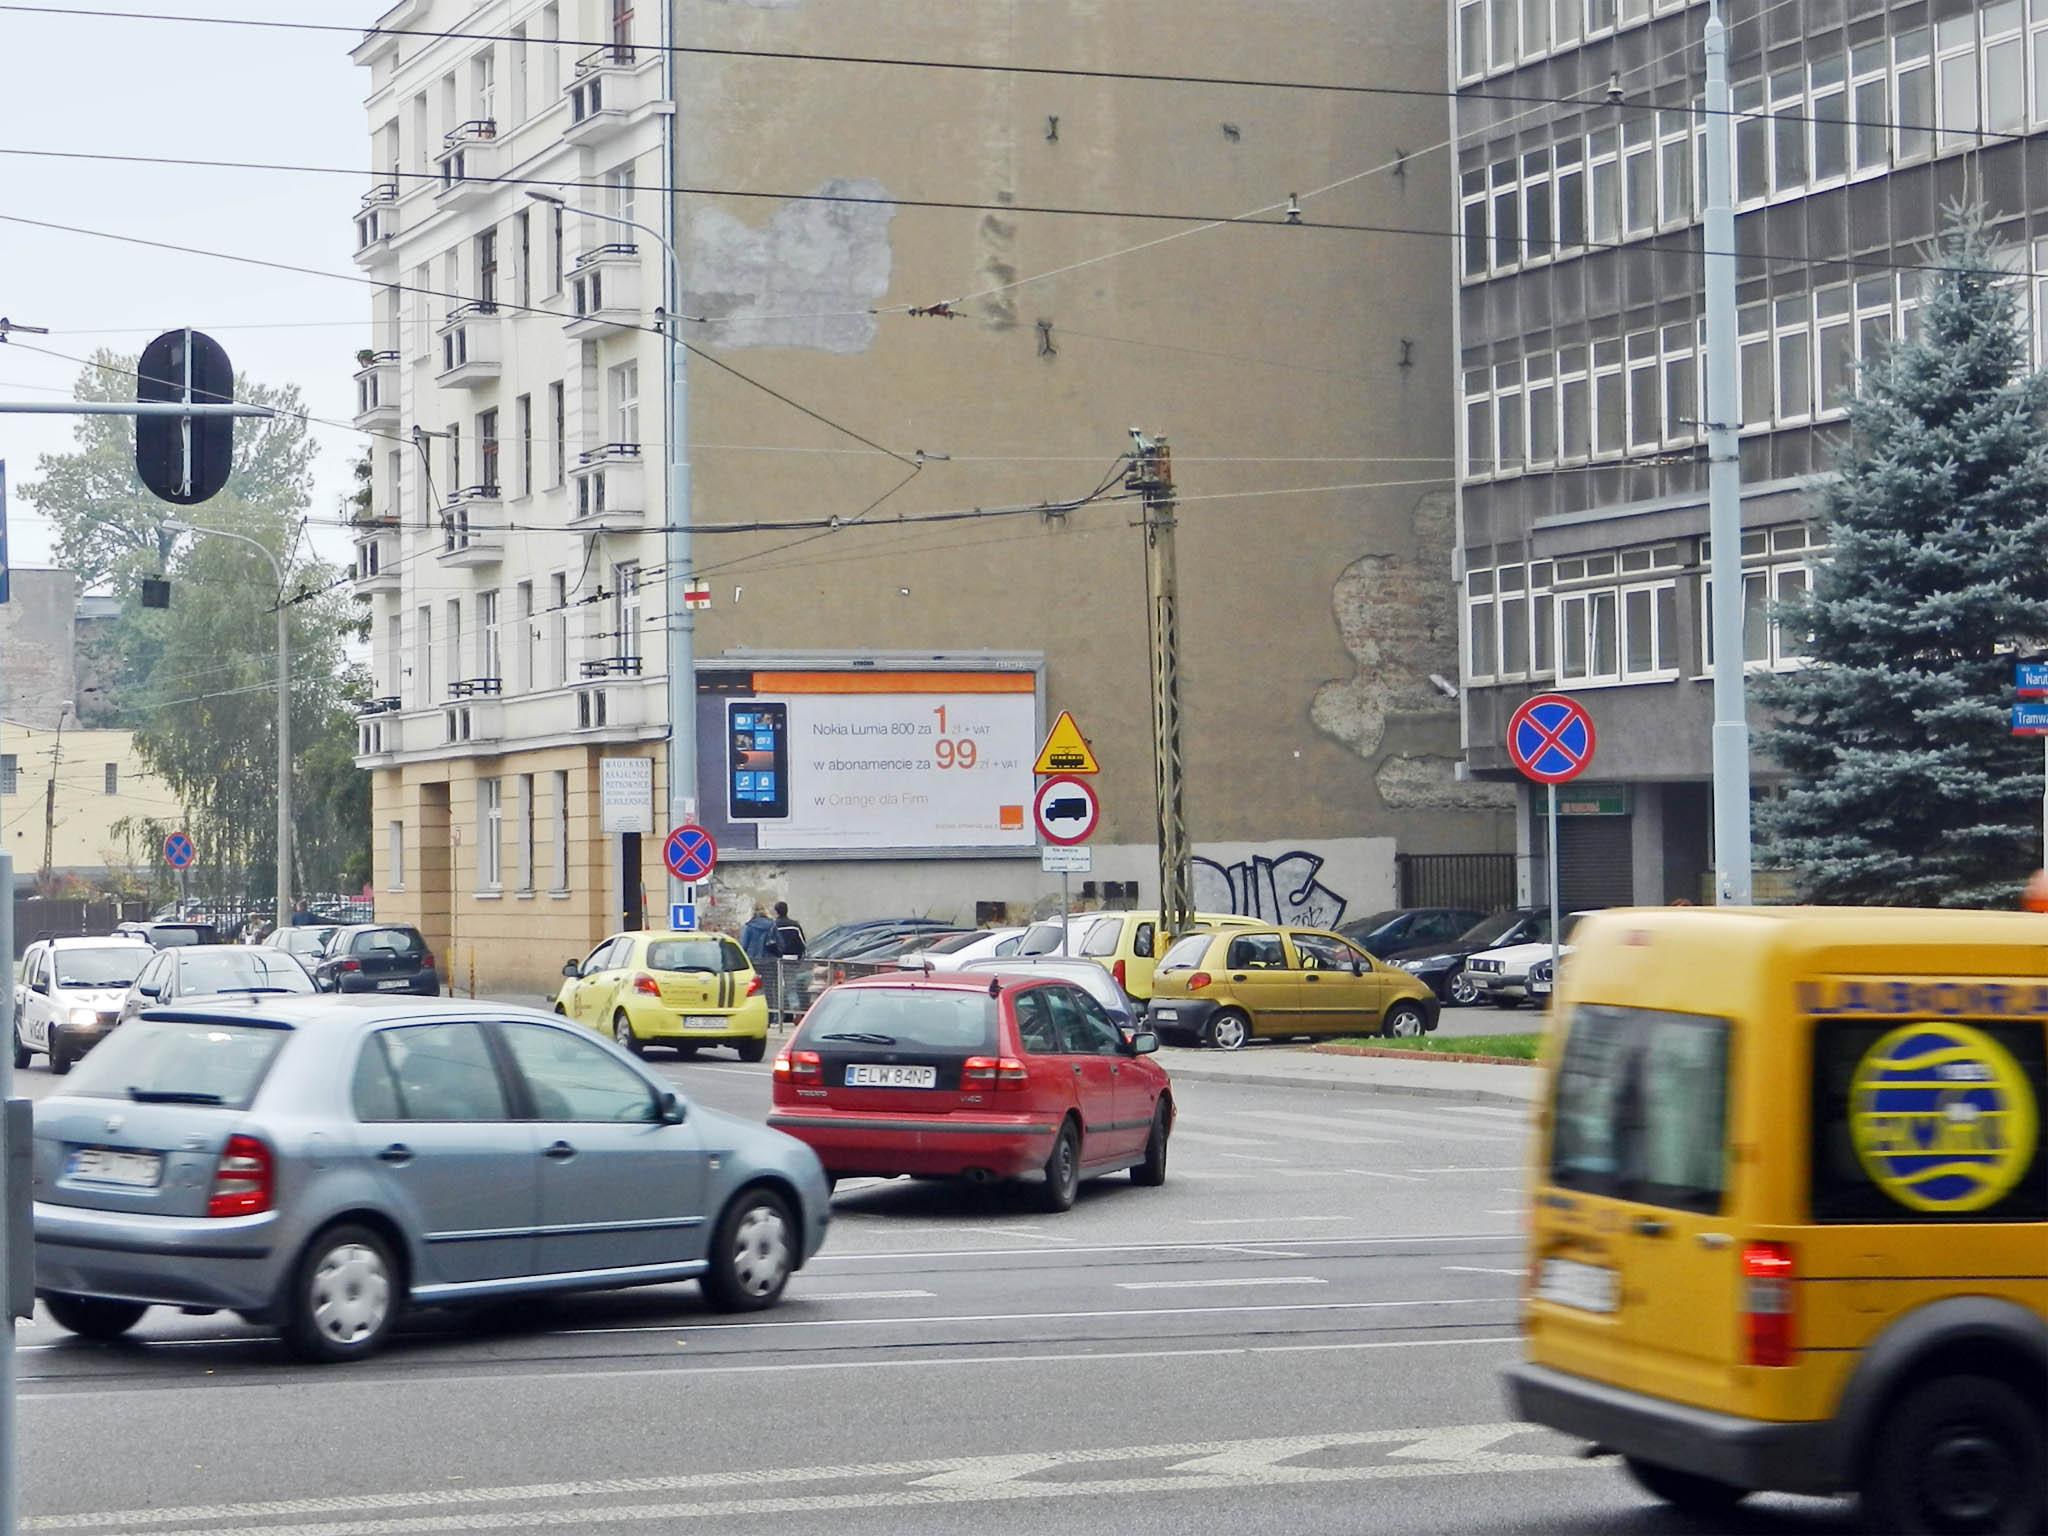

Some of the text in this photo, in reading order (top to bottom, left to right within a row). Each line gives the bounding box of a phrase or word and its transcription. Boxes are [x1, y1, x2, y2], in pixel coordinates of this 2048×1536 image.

[813, 723, 848, 735] Nokia
[852, 723, 887, 735] Lumia
[891, 722, 915, 735] 800
[918, 724, 932, 735] za
[933, 704, 946, 734] 1
[972, 725, 991, 735] VAT
[813, 761, 825, 770] w
[828, 758, 913, 770] abonamencie
[916, 760, 931, 770] za
[935, 739, 977, 769] 99
[1001, 760, 1018, 769] VAT
[814, 792, 929, 808] w Orange dla Firm
[679, 909, 690, 926] L
[856, 1067, 932, 1085] ELW 84NP
